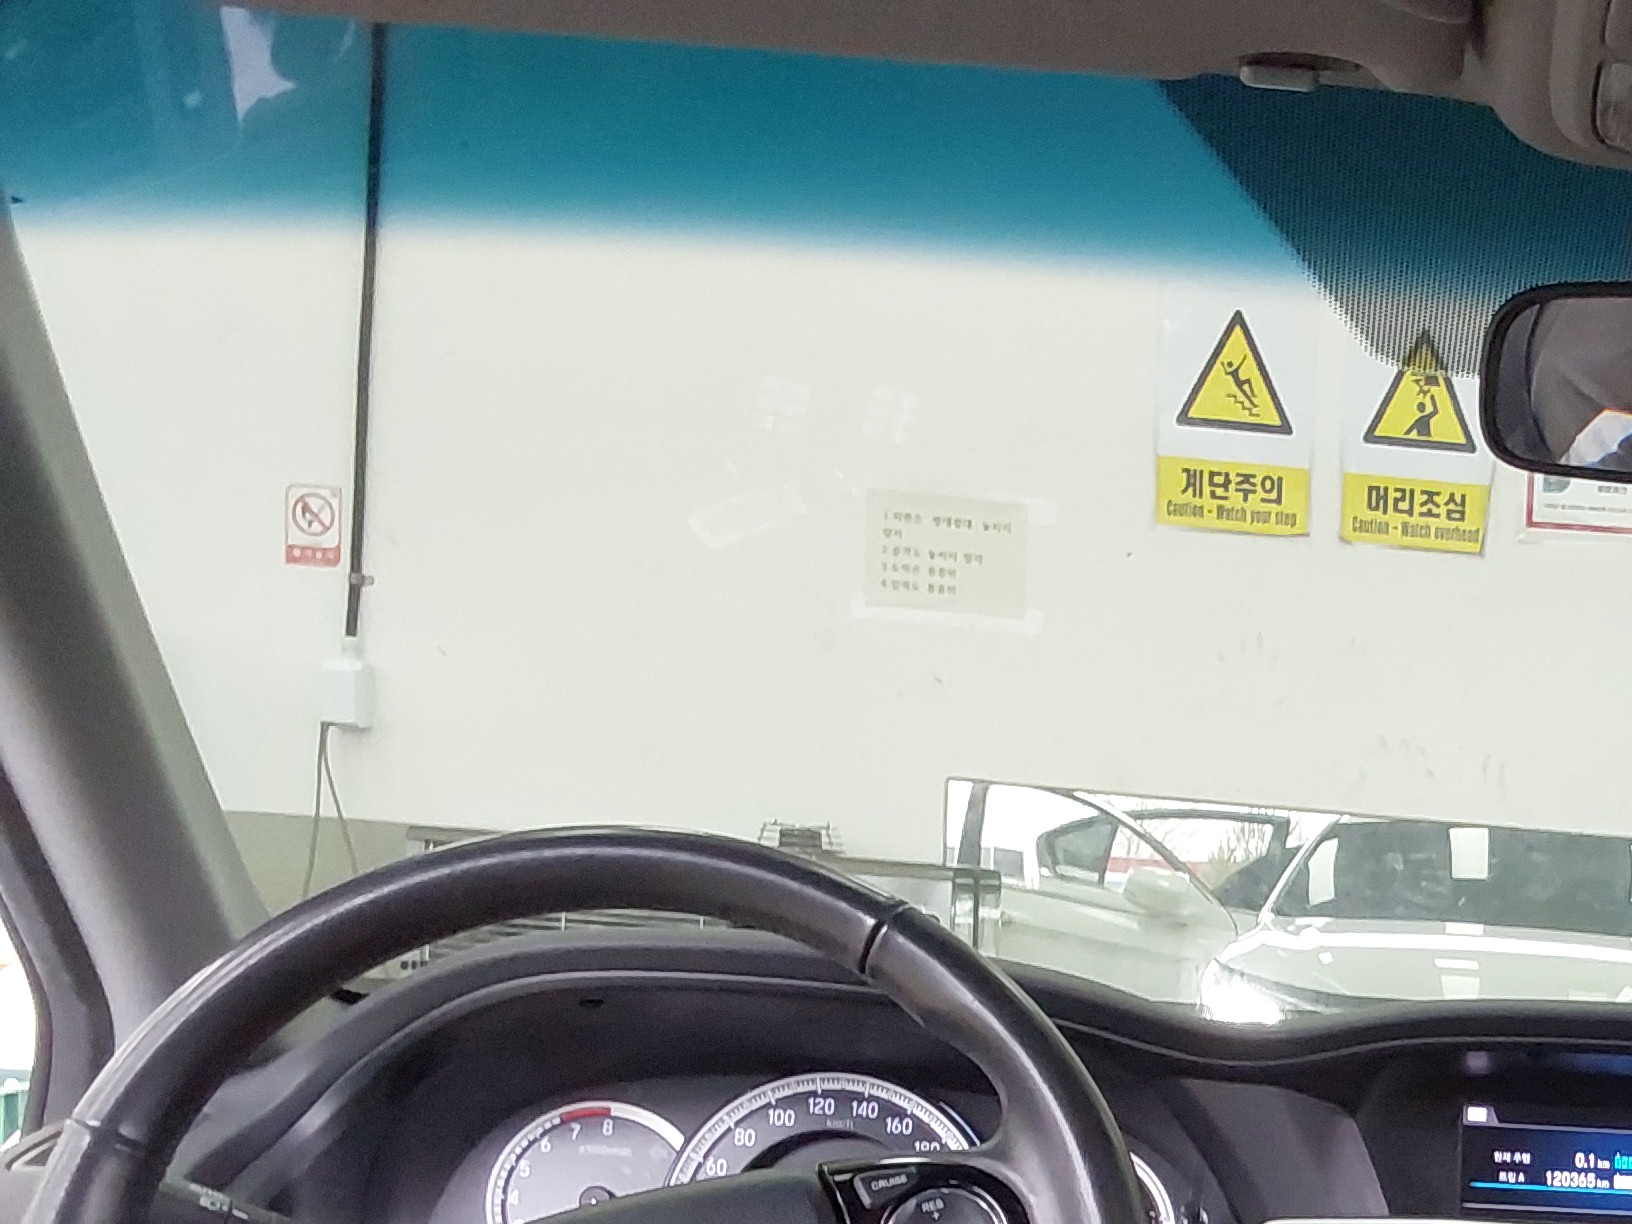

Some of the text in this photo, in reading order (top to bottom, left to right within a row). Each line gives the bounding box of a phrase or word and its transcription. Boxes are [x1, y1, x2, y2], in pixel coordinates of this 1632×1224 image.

[1181, 468, 1283, 506] 계단주의
[1367, 486, 1466, 522] 머리조심
[1167, 500, 1204, 518] Caution
[1216, 504, 1247, 523] Watch
[1250, 510, 1272, 525] your
[1275, 510, 1297, 528] step
[1352, 516, 1389, 535] Caution
[1401, 521, 1431, 539] Watch
[1434, 526, 1480, 543] overhead
[808, 1098, 835, 1115] 120
[852, 1101, 878, 1119] 140
[768, 1109, 795, 1126] 100
[886, 1117, 912, 1135] 160
[570, 1122, 581, 1140] 7
[602, 1118, 614, 1136] 8
[540, 1136, 551, 1153] 6
[734, 1128, 755, 1146] 80
[520, 1160, 531, 1177] 5
[706, 1158, 727, 1175] 60
[1575, 1152, 1595, 1169] 0.1
[871, 1174, 908, 1191] CRUISE
[1546, 1170, 1596, 1189] 120365
[508, 1189, 519, 1206] 4
[921, 1198, 944, 1213] RES
